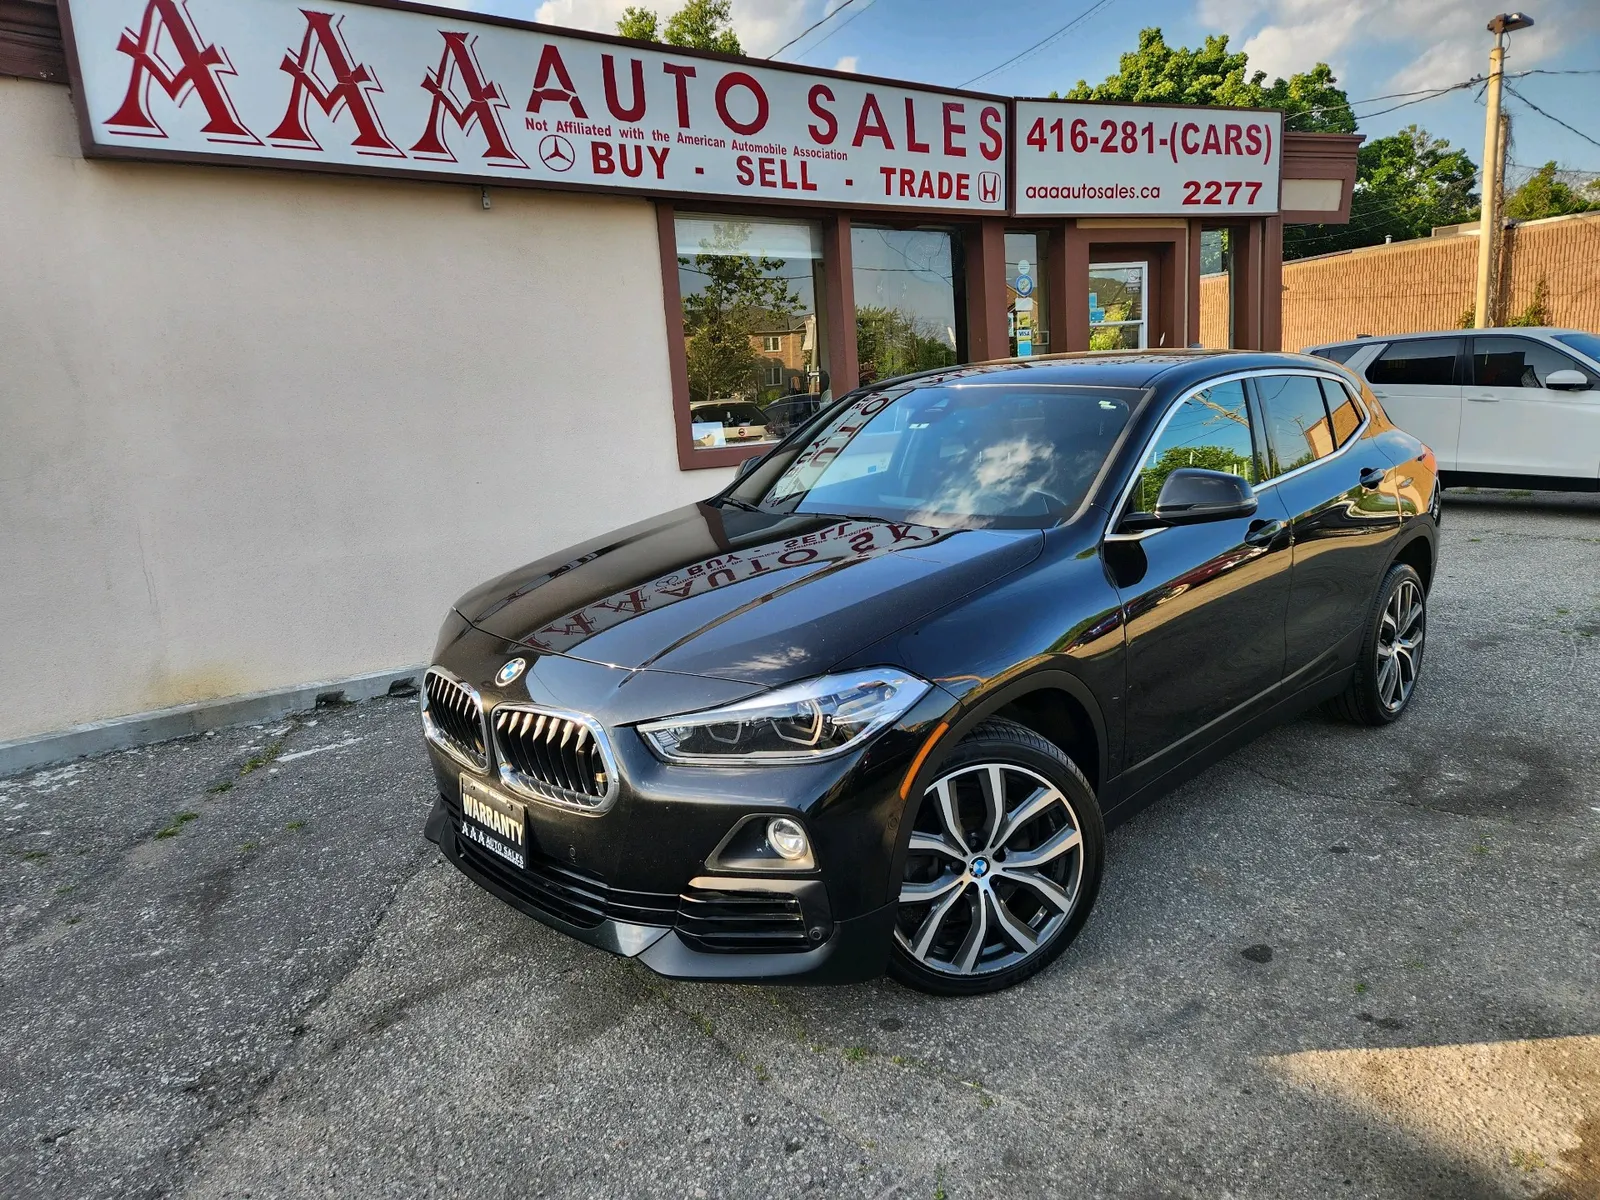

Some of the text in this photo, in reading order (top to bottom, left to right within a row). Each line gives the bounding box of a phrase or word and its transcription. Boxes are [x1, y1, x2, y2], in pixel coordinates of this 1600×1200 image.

[525, 44, 770, 135] AUTO
[807, 83, 1004, 162] SALES
[525, 117, 848, 161] Not Affiliated with the American Automobile Association
[1026, 117, 1272, 165] 416-281-(CARS)
[591, 140, 671, 180] BUY
[736, 155, 818, 191] SELL
[880, 167, 970, 201] TRADE
[1025, 183, 1160, 200] aaaautosales.ca
[1182, 180, 1263, 205] 2277
[462, 792, 523, 846] WARRANTY
[485, 835, 502, 852] AUTO
[503, 845, 524, 865] SALES
